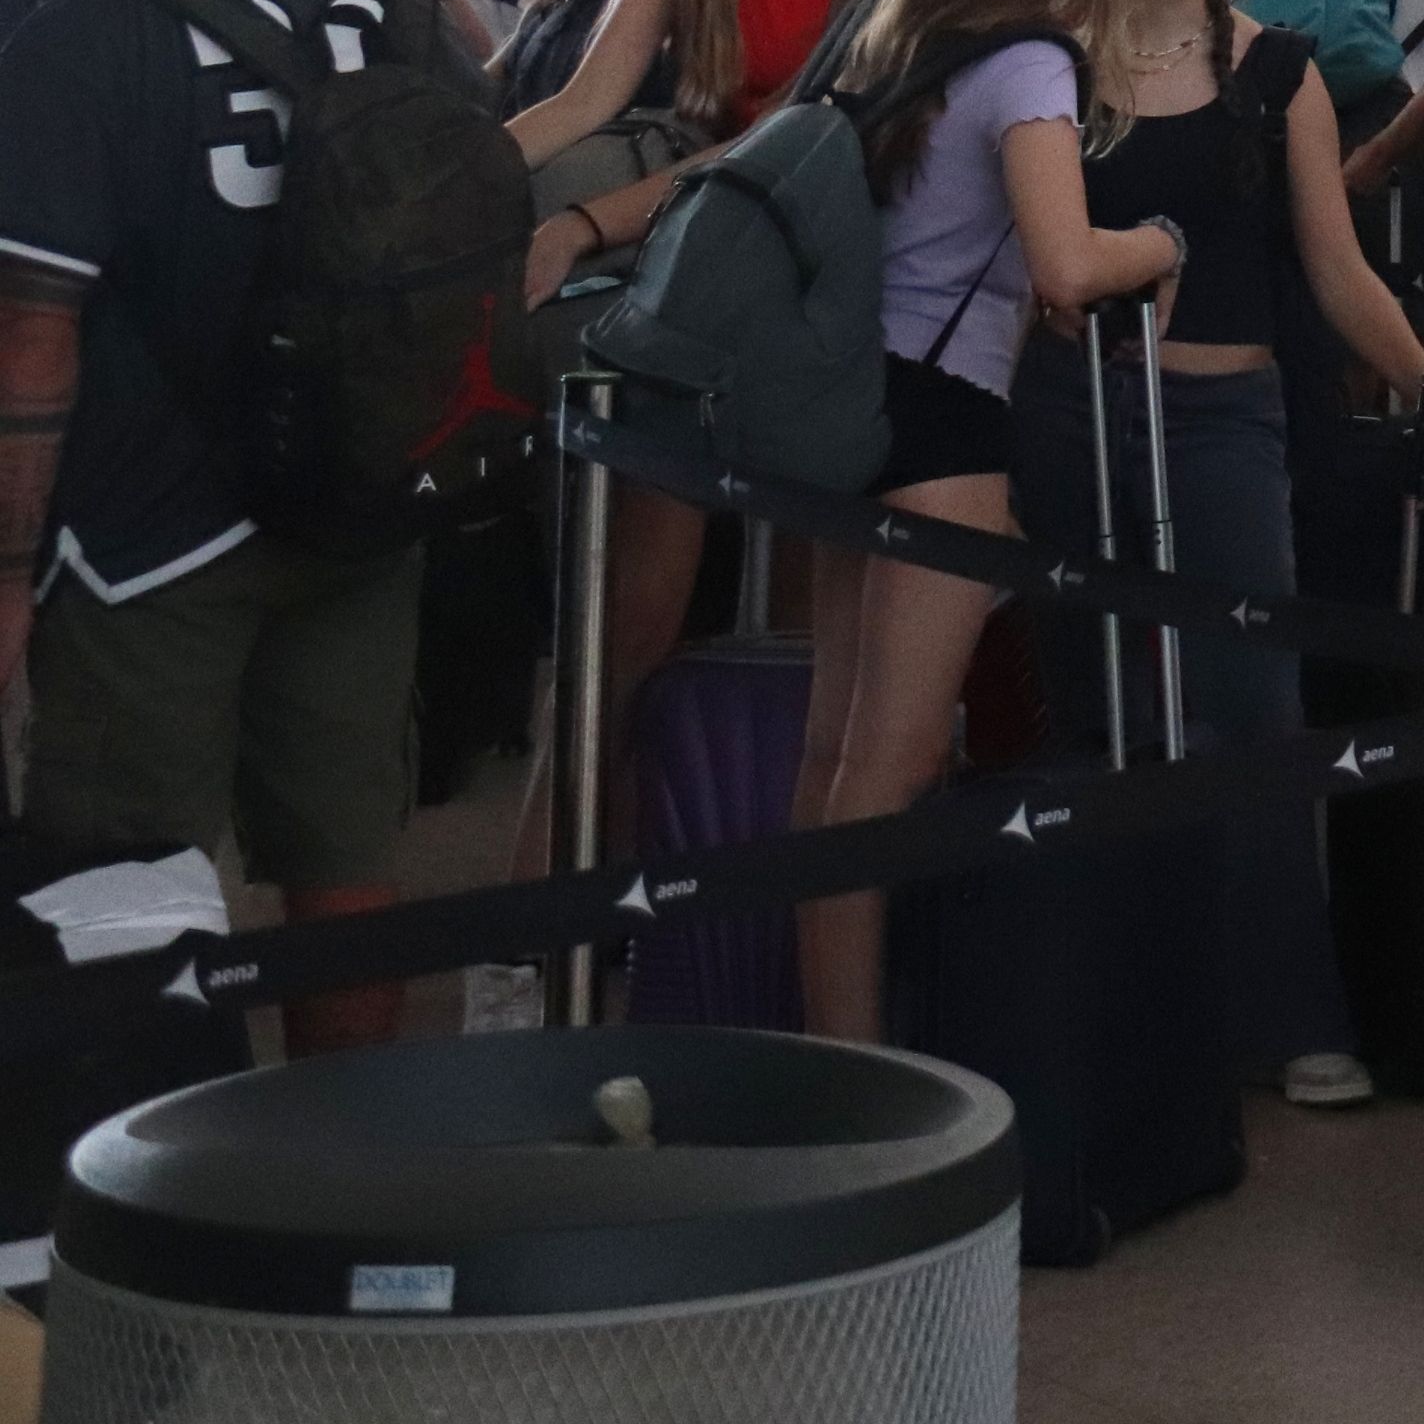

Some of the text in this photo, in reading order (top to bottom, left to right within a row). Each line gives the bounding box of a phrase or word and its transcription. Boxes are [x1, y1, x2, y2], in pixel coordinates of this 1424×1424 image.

[1361, 744, 1395, 765] aena
[1033, 806, 1071, 828] aena
[655, 878, 698, 901] aena
[208, 962, 260, 988] aena
